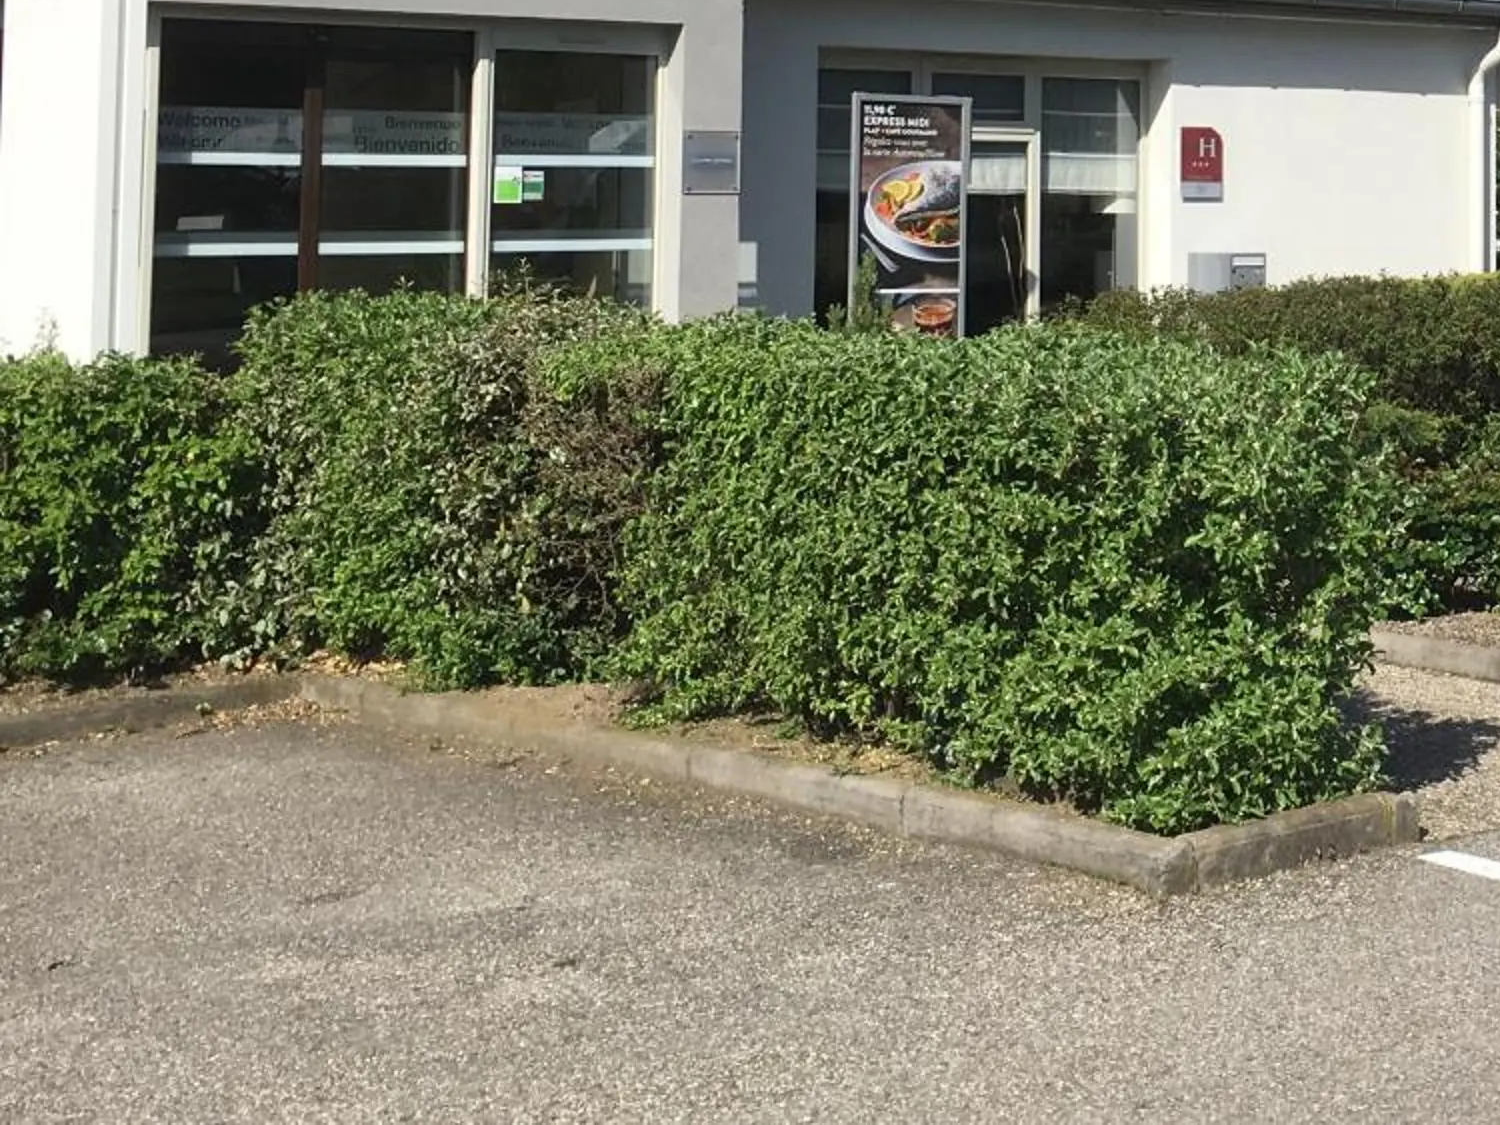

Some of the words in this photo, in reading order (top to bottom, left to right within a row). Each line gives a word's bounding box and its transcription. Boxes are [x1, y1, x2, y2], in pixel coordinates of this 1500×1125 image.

[863, 116, 905, 127] EXPRESS
[907, 118, 929, 128] MIDI
[1199, 137, 1216, 157] H
